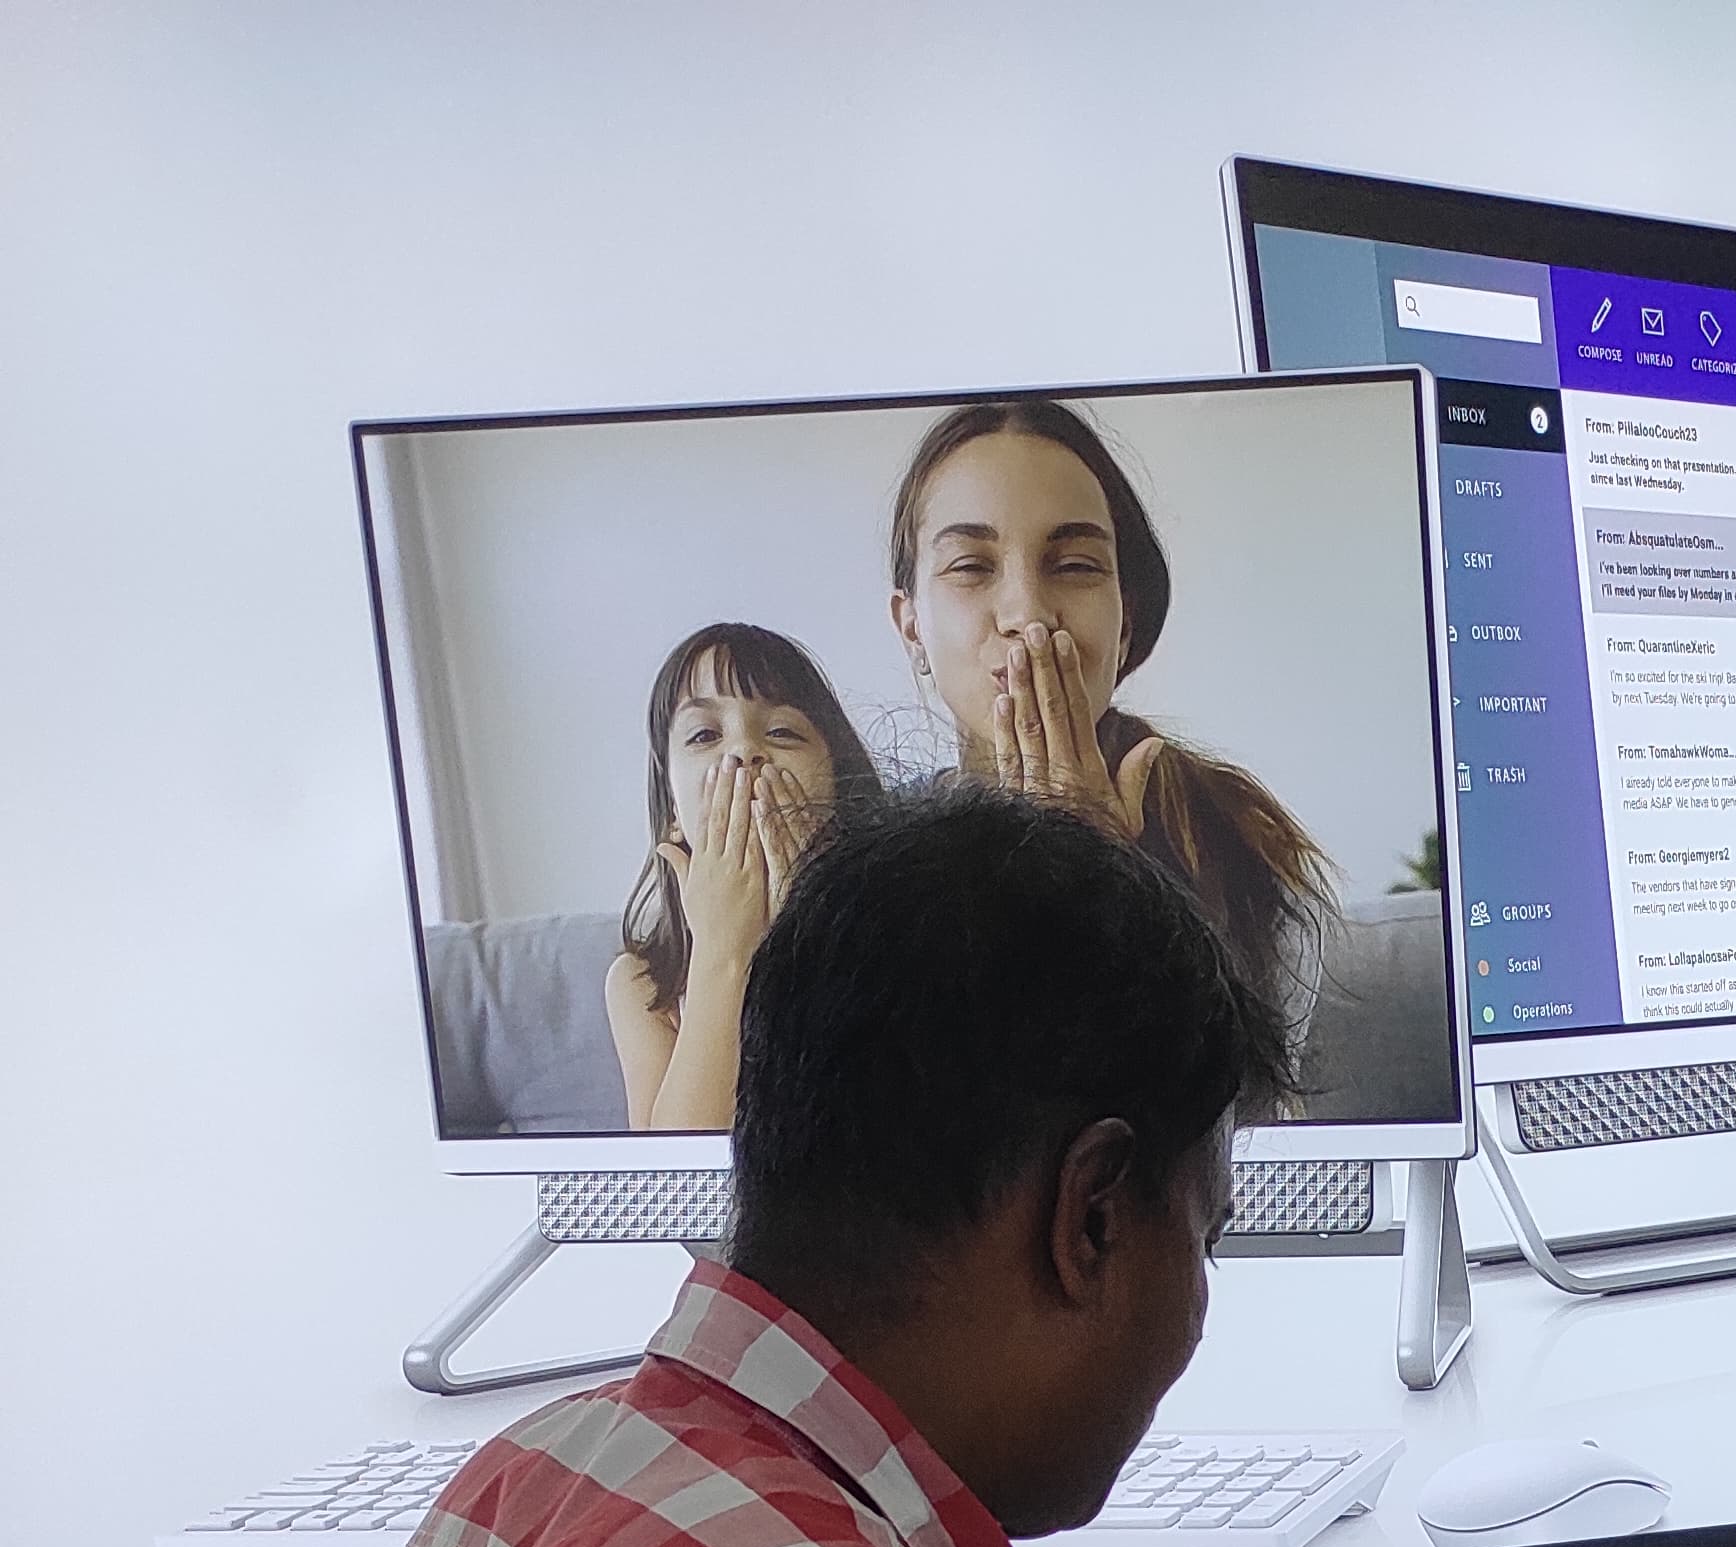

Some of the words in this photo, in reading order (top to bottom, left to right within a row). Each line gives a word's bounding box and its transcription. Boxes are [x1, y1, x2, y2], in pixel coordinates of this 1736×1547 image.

[1577, 344, 1622, 363] COMPOSE
[1636, 352, 1673, 368] UNREAD
[1448, 405, 1486, 425] INBOX
[1535, 414, 1544, 429] 2
[1585, 417, 1614, 433] From:
[1617, 421, 1697, 440] PillalooCouch23
[1590, 473, 1613, 484] since
[1615, 473, 1632, 486] last
[1455, 479, 1503, 498] DRAFTS
[1596, 529, 1624, 544] From:
[1463, 551, 1493, 570] SENT
[1471, 625, 1522, 641] OUTBOX
[1606, 637, 1635, 651] From:
[1479, 695, 1547, 713] IMPORTANT
[1617, 745, 1646, 758] From:
[1487, 766, 1526, 784] TRASH
[1628, 850, 1655, 864] From:
[1502, 904, 1552, 921] GROUPS
[1507, 956, 1541, 973] Social
[1638, 954, 1666, 967] From:
[1513, 1001, 1573, 1020] Operations
